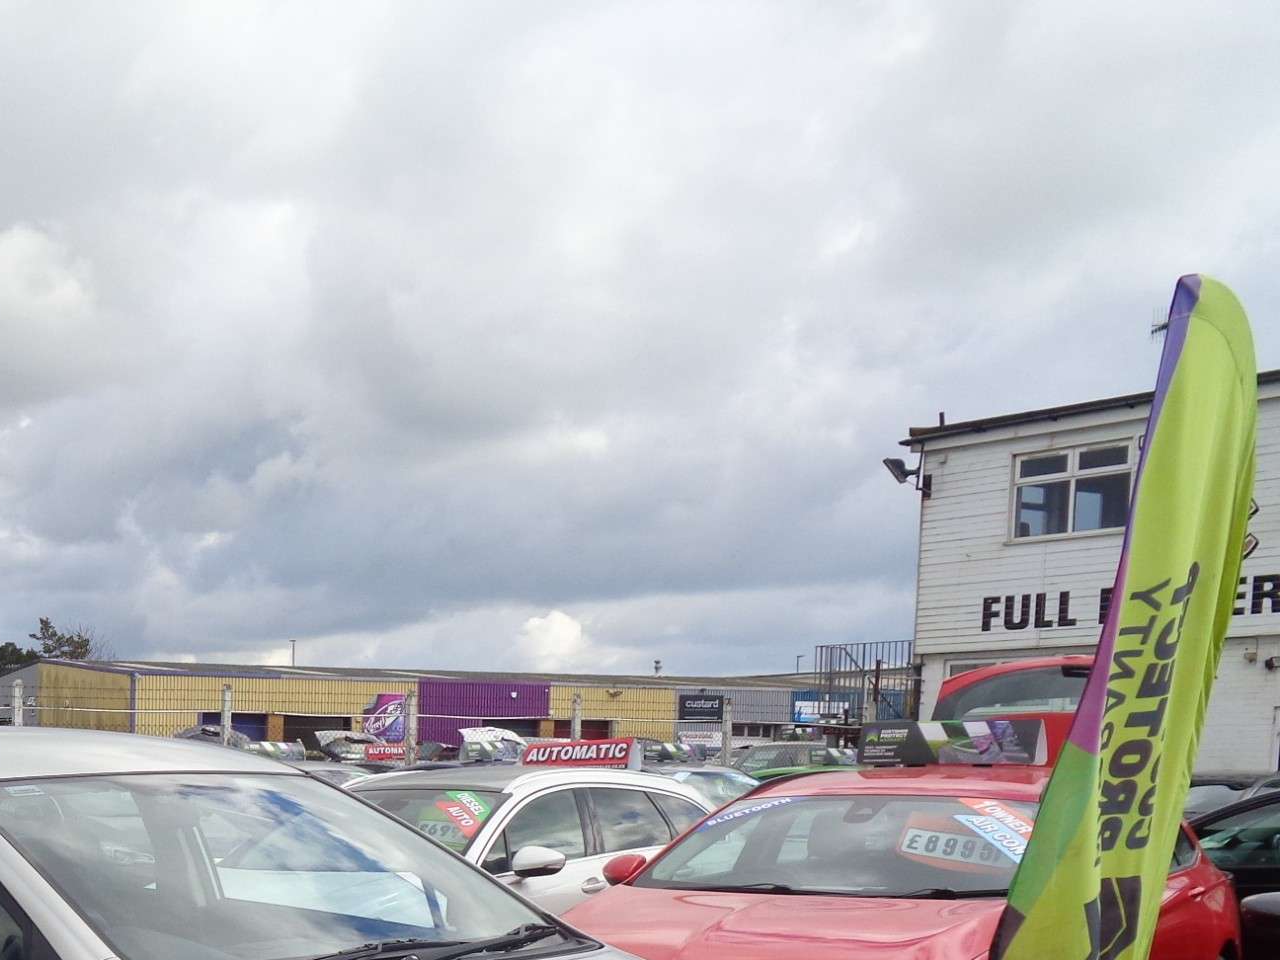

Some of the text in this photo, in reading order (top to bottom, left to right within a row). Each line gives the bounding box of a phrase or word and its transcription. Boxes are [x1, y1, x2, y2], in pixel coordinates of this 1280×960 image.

[981, 591, 1077, 632] FULL
[368, 746, 406, 754] AUTOMA
[526, 743, 628, 762] AUTOMATIC
[456, 792, 485, 816] DIESEL
[706, 798, 793, 826] BLUETOOTH
[447, 806, 474, 827] AUTO
[967, 815, 996, 833] AIR
[987, 801, 1033, 834] OWNER
